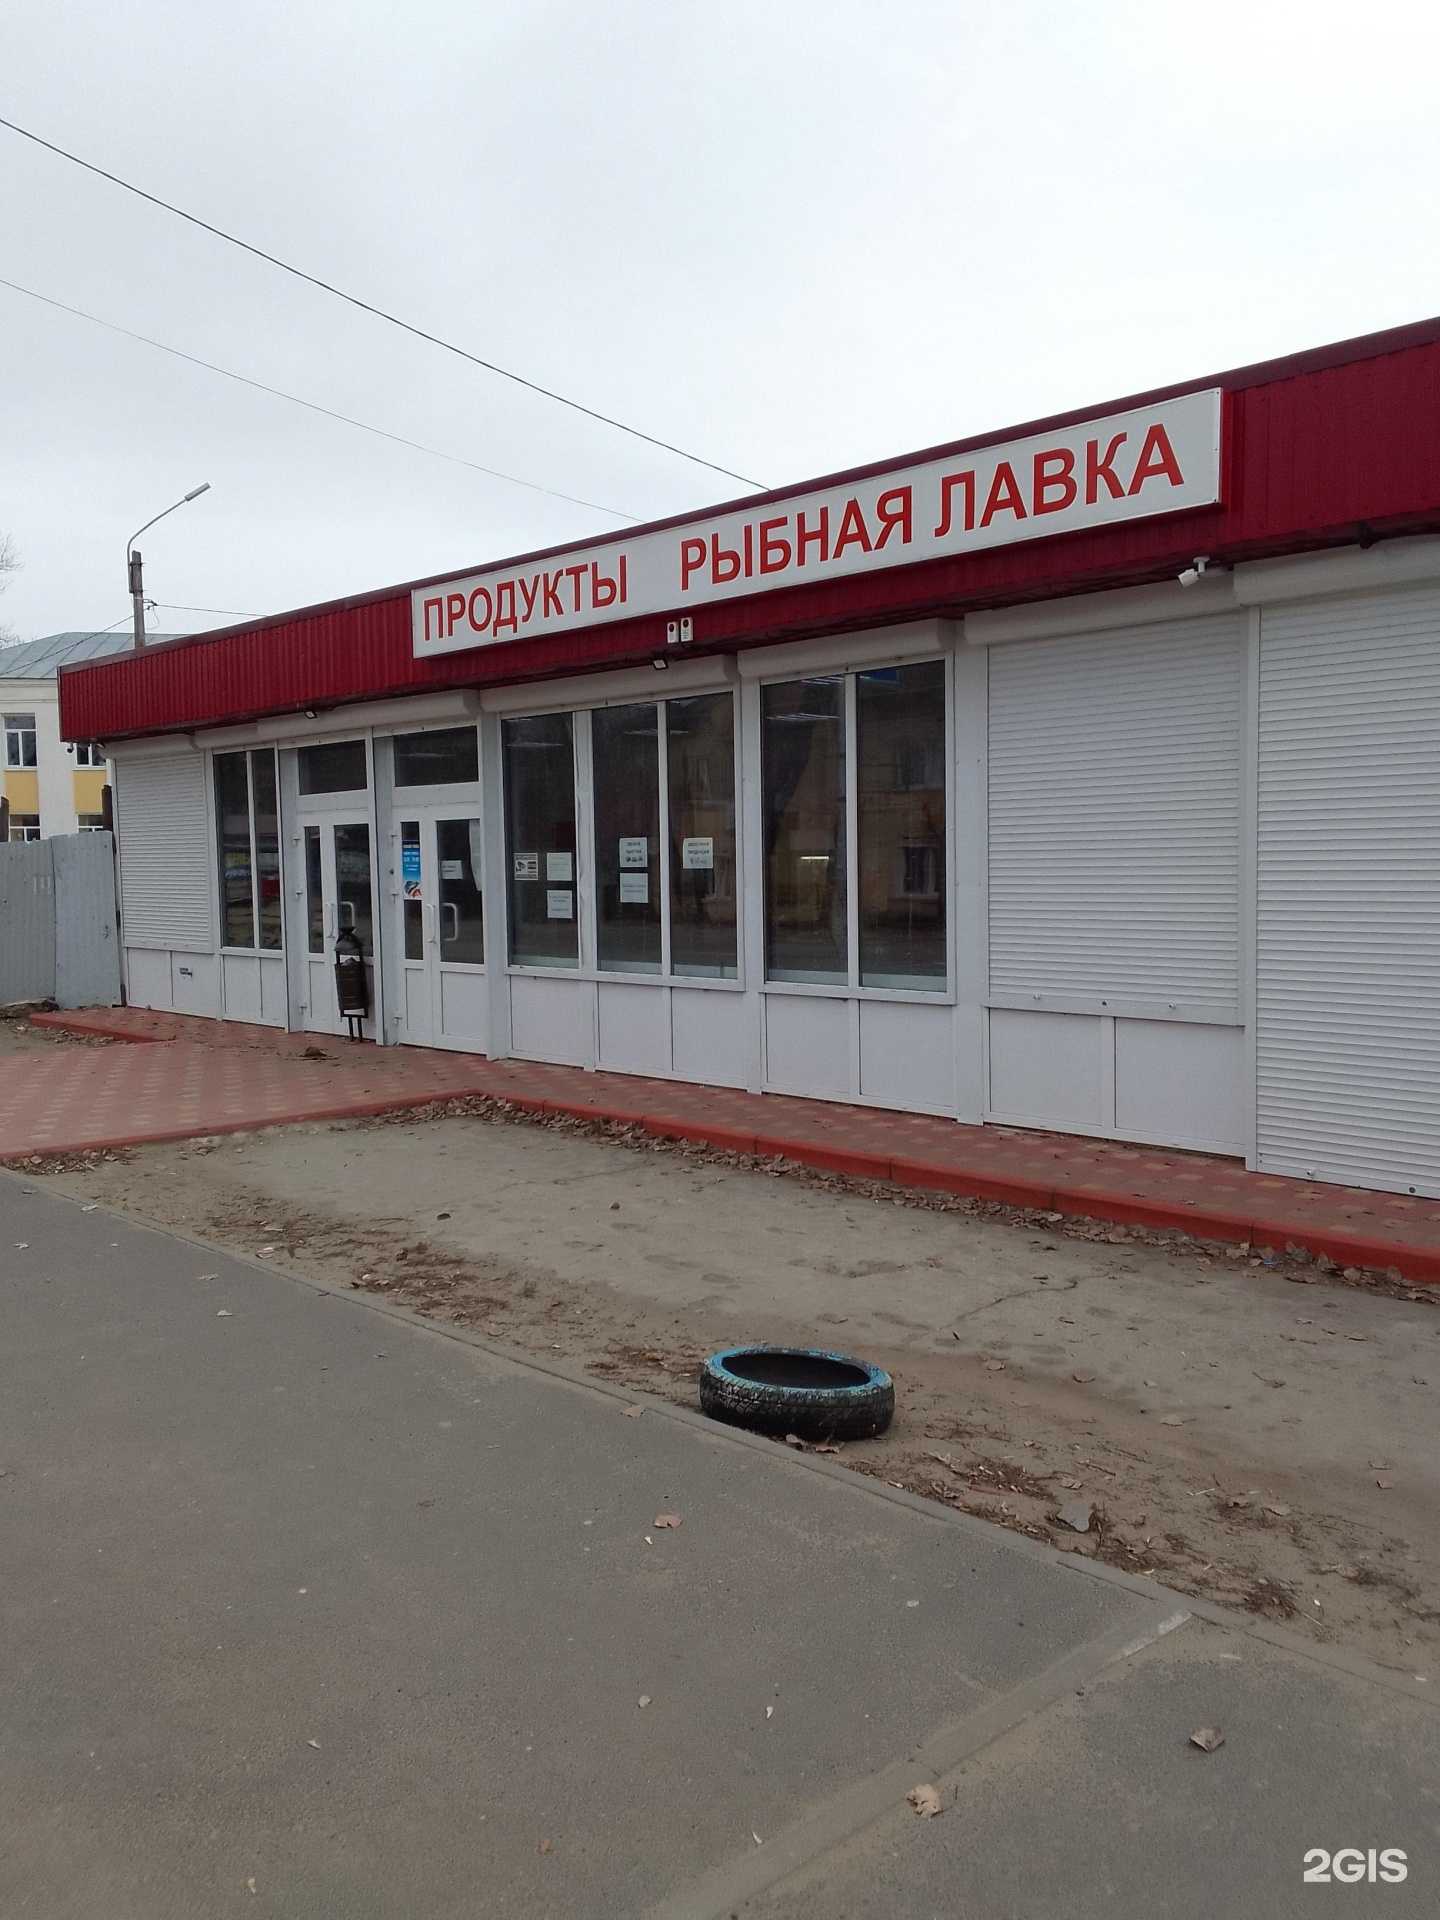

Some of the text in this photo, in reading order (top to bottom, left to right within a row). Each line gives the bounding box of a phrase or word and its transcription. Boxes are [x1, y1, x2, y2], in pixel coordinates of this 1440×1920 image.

[423, 424, 1184, 641] ПРОДУКТЫ РЫБНАЯ ЛАВКА
